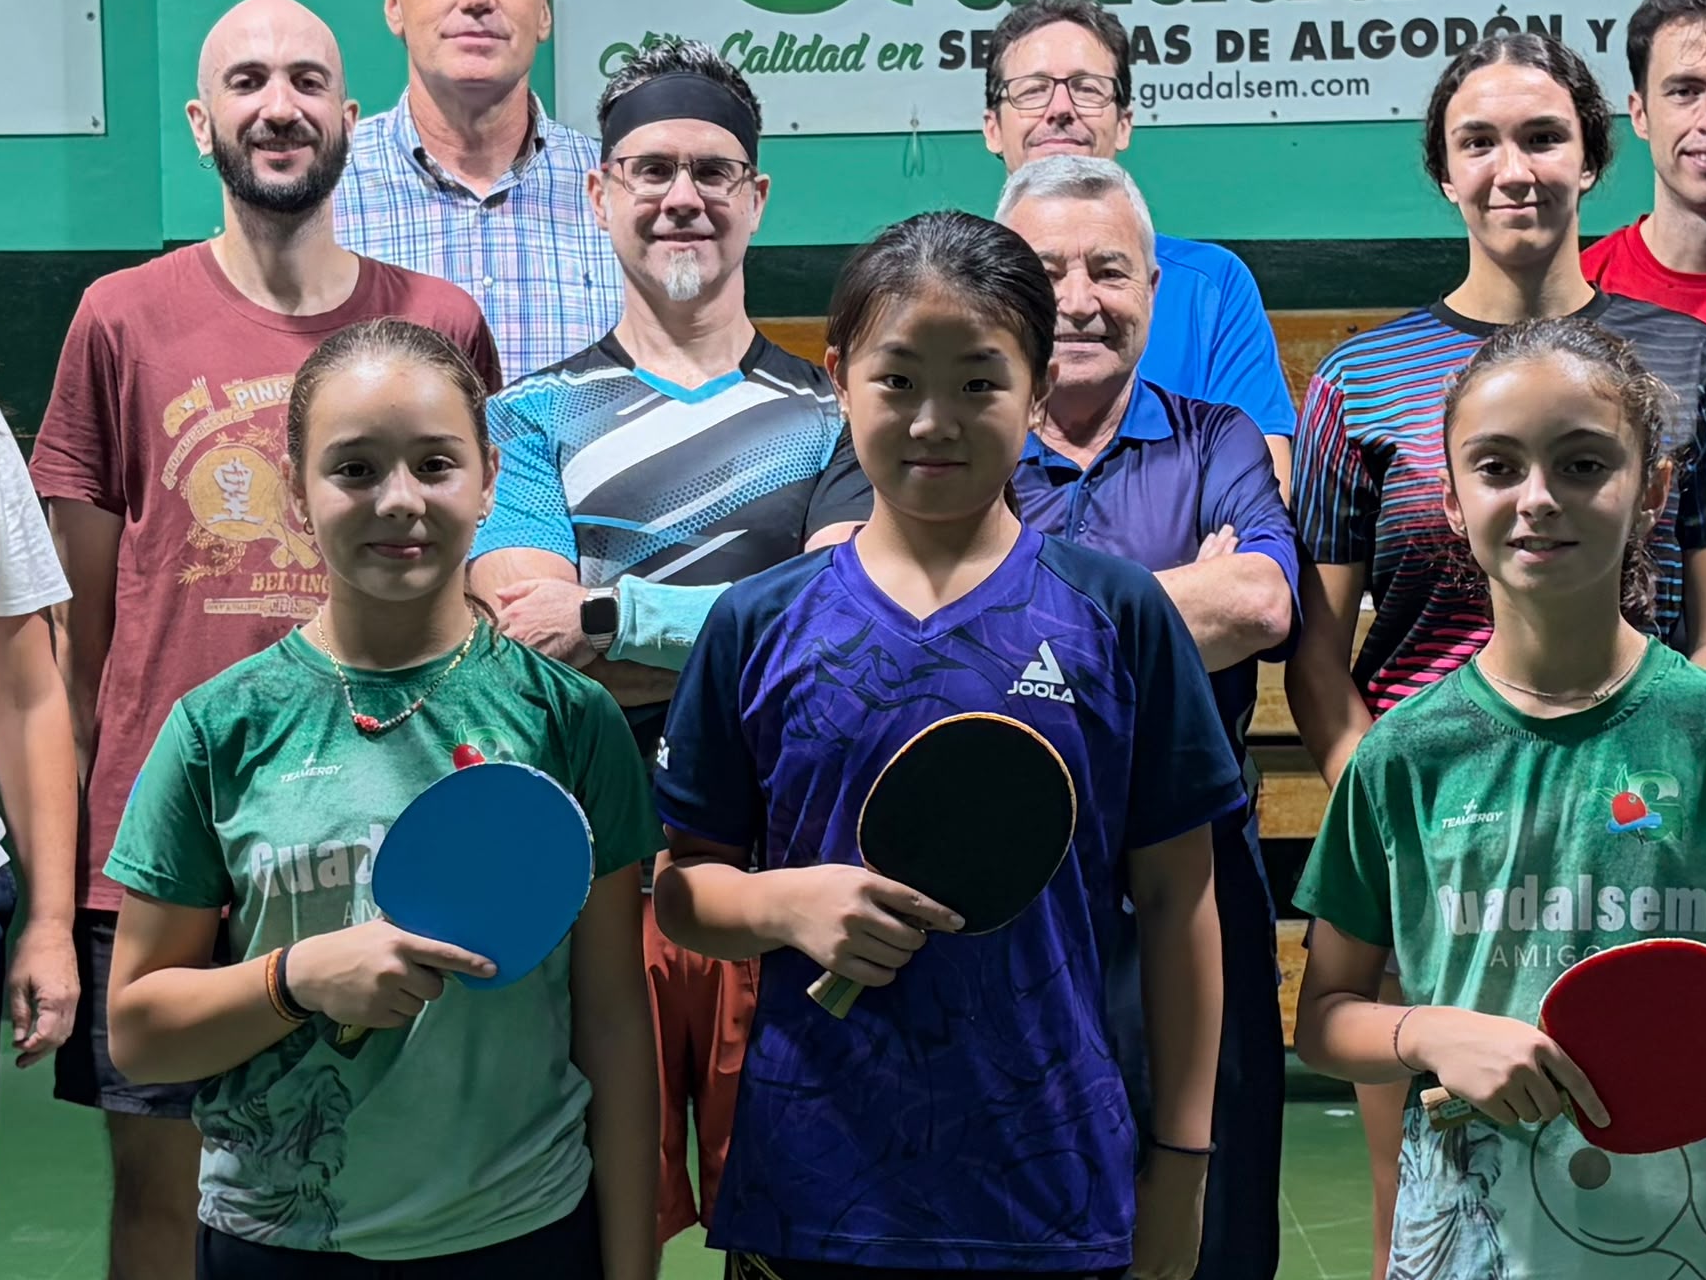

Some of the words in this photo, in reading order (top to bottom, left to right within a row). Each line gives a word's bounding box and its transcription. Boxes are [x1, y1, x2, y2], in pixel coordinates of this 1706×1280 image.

[878, 43, 923, 70] en
[1216, 28, 1270, 63] DE
[1587, 18, 1616, 53] Y
[1007, 680, 1076, 704] JOOLA
[1490, 944, 1603, 968] AMIG
